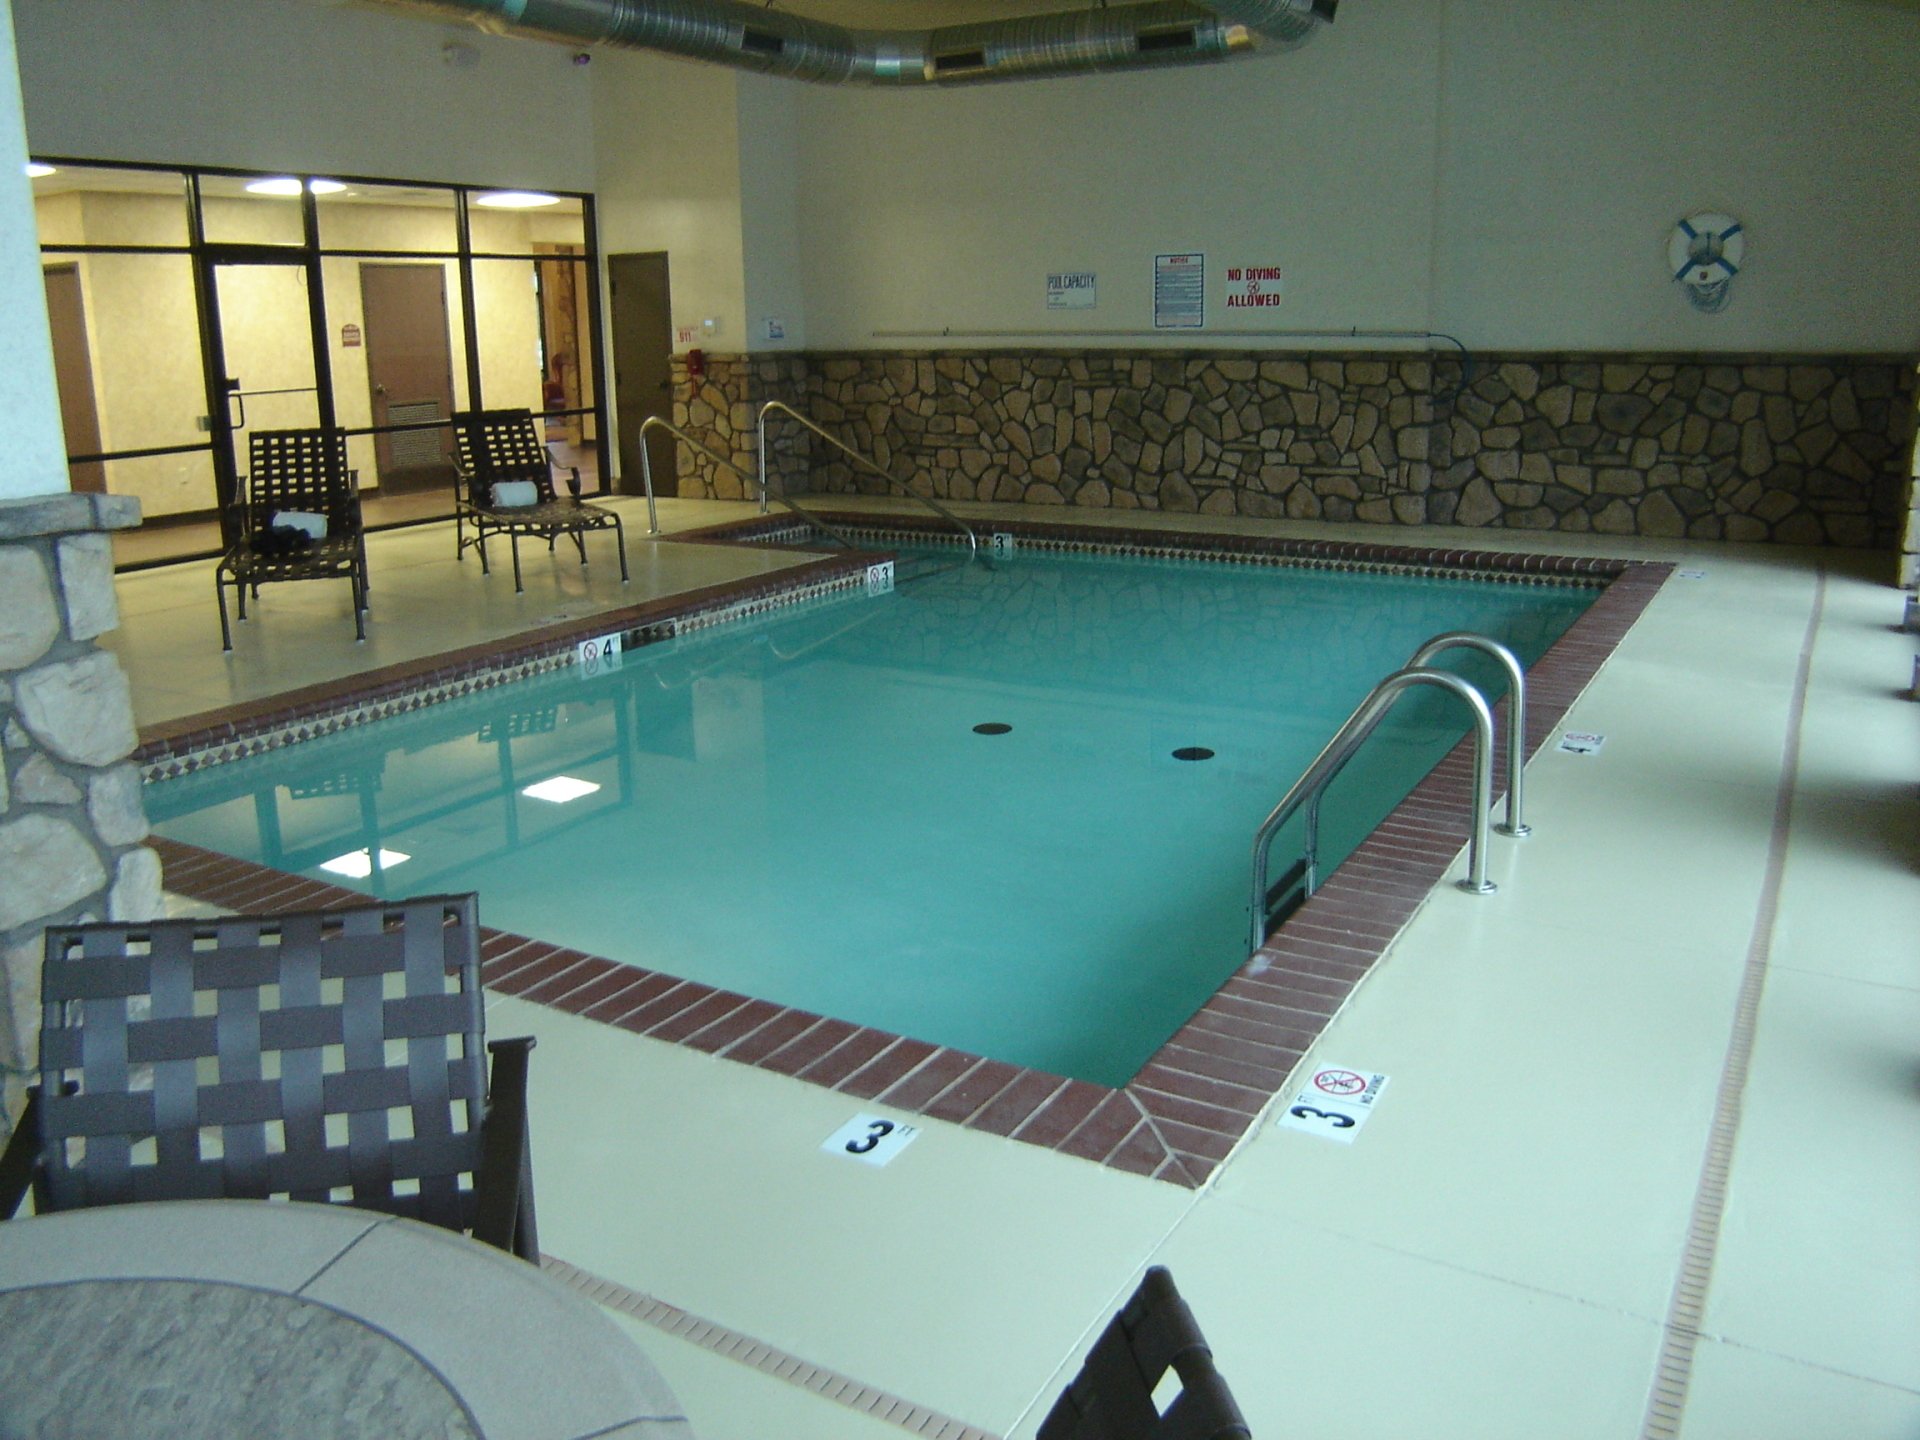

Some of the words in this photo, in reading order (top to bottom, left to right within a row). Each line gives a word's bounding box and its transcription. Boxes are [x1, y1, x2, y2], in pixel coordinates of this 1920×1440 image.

[1048, 275, 1062, 289] POOL
[1063, 273, 1095, 289] CAPACITY
[1227, 268, 1241, 281] NO
[1246, 267, 1281, 280] DIVING
[1227, 293, 1280, 307] ALLOWED
[995, 535, 1004, 548] 3
[603, 638, 613, 655] 4
[1290, 1105, 1356, 1128] 3
[845, 1119, 895, 1154] 3
[897, 1124, 916, 1137] FT
